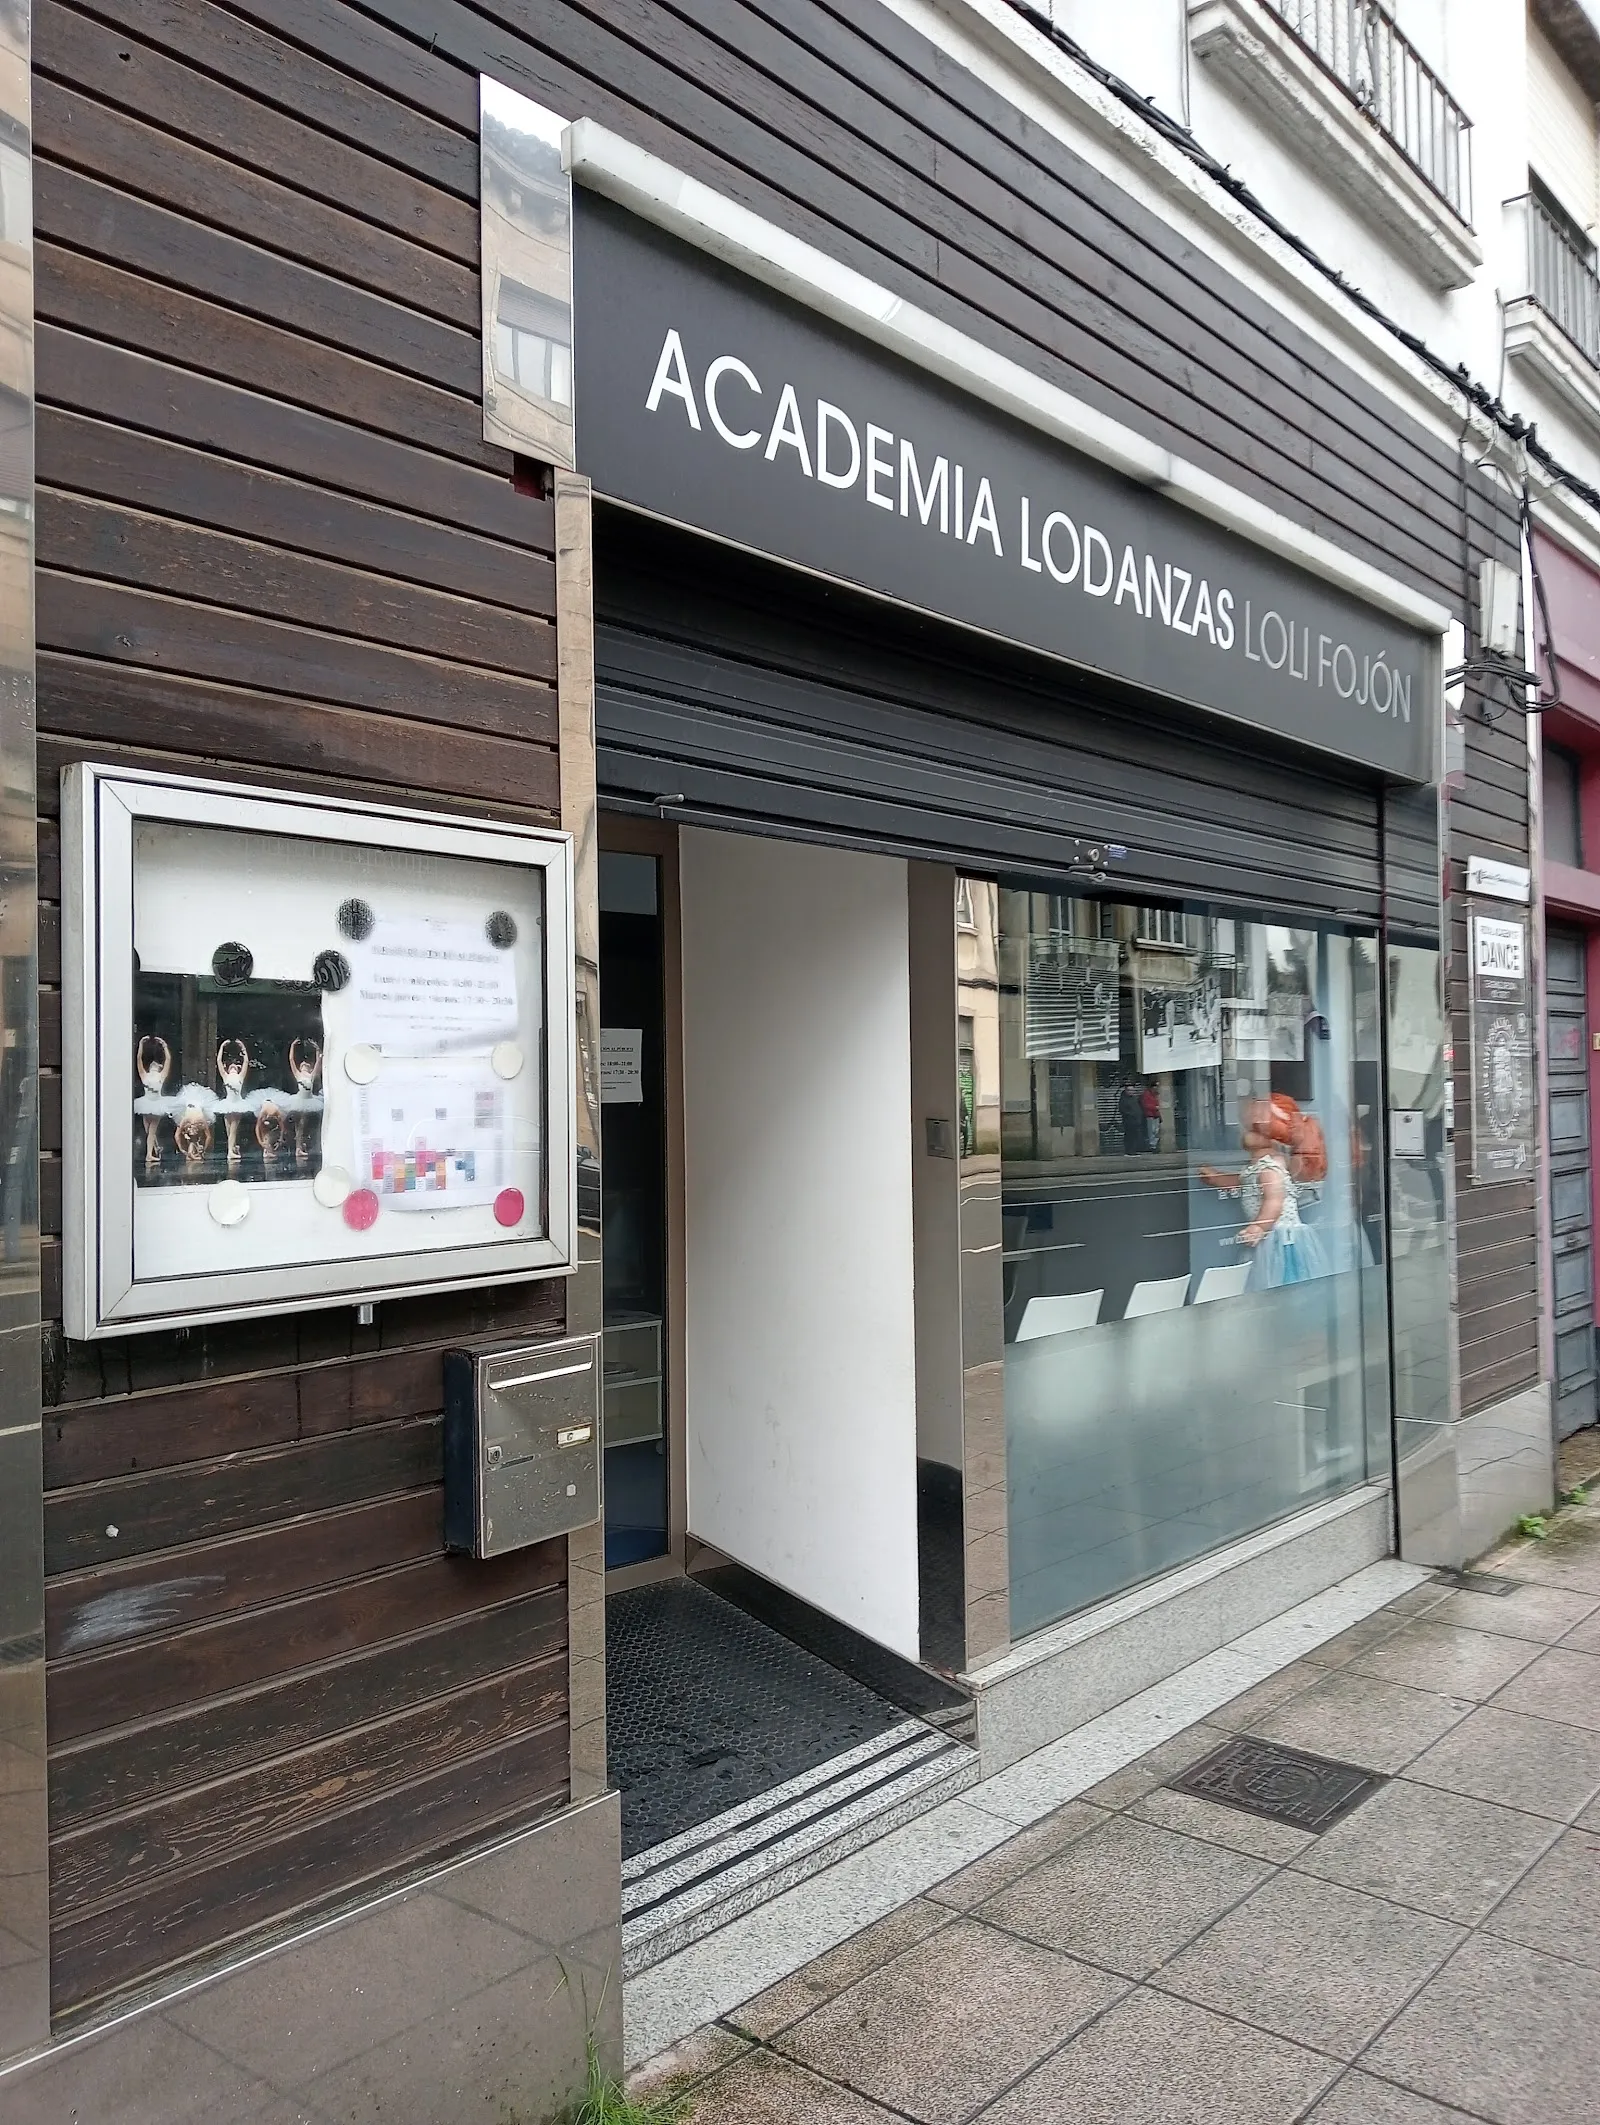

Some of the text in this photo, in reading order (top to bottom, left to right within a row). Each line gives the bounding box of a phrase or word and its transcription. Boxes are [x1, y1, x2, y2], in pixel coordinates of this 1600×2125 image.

[645, 328, 1411, 723] ACADEMIA LODANZAS LOLI FOJÓN
[1480, 940, 1520, 971] DANCE
